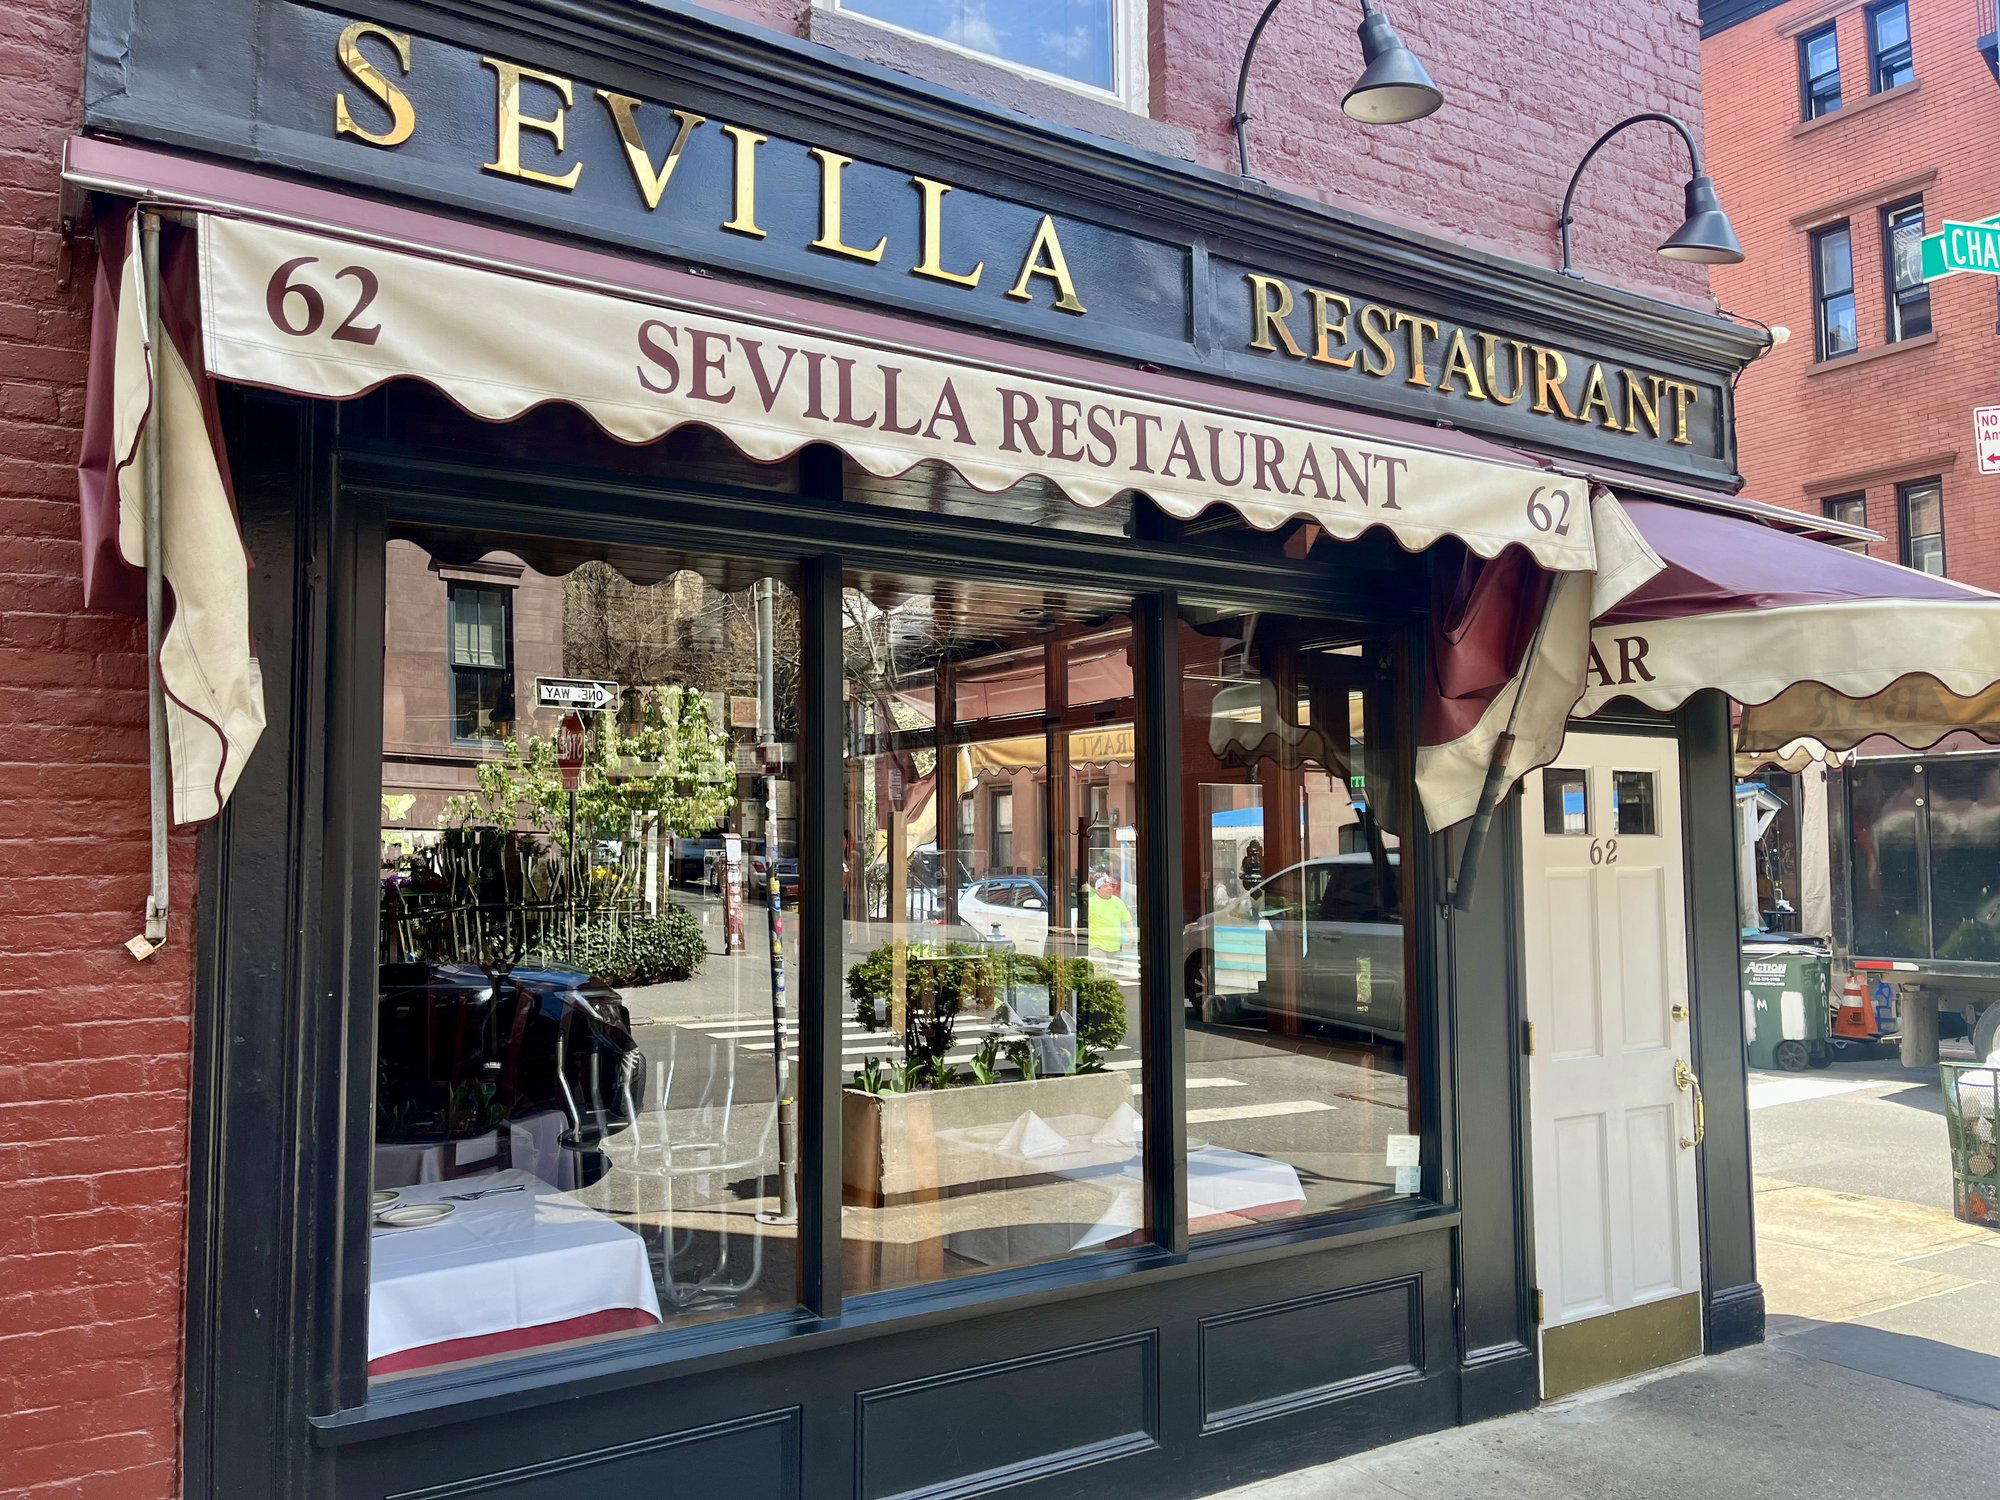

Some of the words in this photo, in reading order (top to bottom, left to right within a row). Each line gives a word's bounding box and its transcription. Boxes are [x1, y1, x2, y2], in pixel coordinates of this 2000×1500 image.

[334, 21, 1087, 315] SEVILLA
[266, 256, 381, 345] 62
[1246, 273, 1698, 445] RESTAURANT
[636, 319, 977, 446] SEVILLA
[996, 386, 1407, 510] RESTAURANT
[1982, 415, 1998, 426] NO
[1984, 430, 2000, 441] An
[1526, 485, 1570, 536] 62
[1586, 636, 1656, 688] AR
[1590, 838, 1618, 866] 62
[1744, 962, 1787, 973] ACTION
